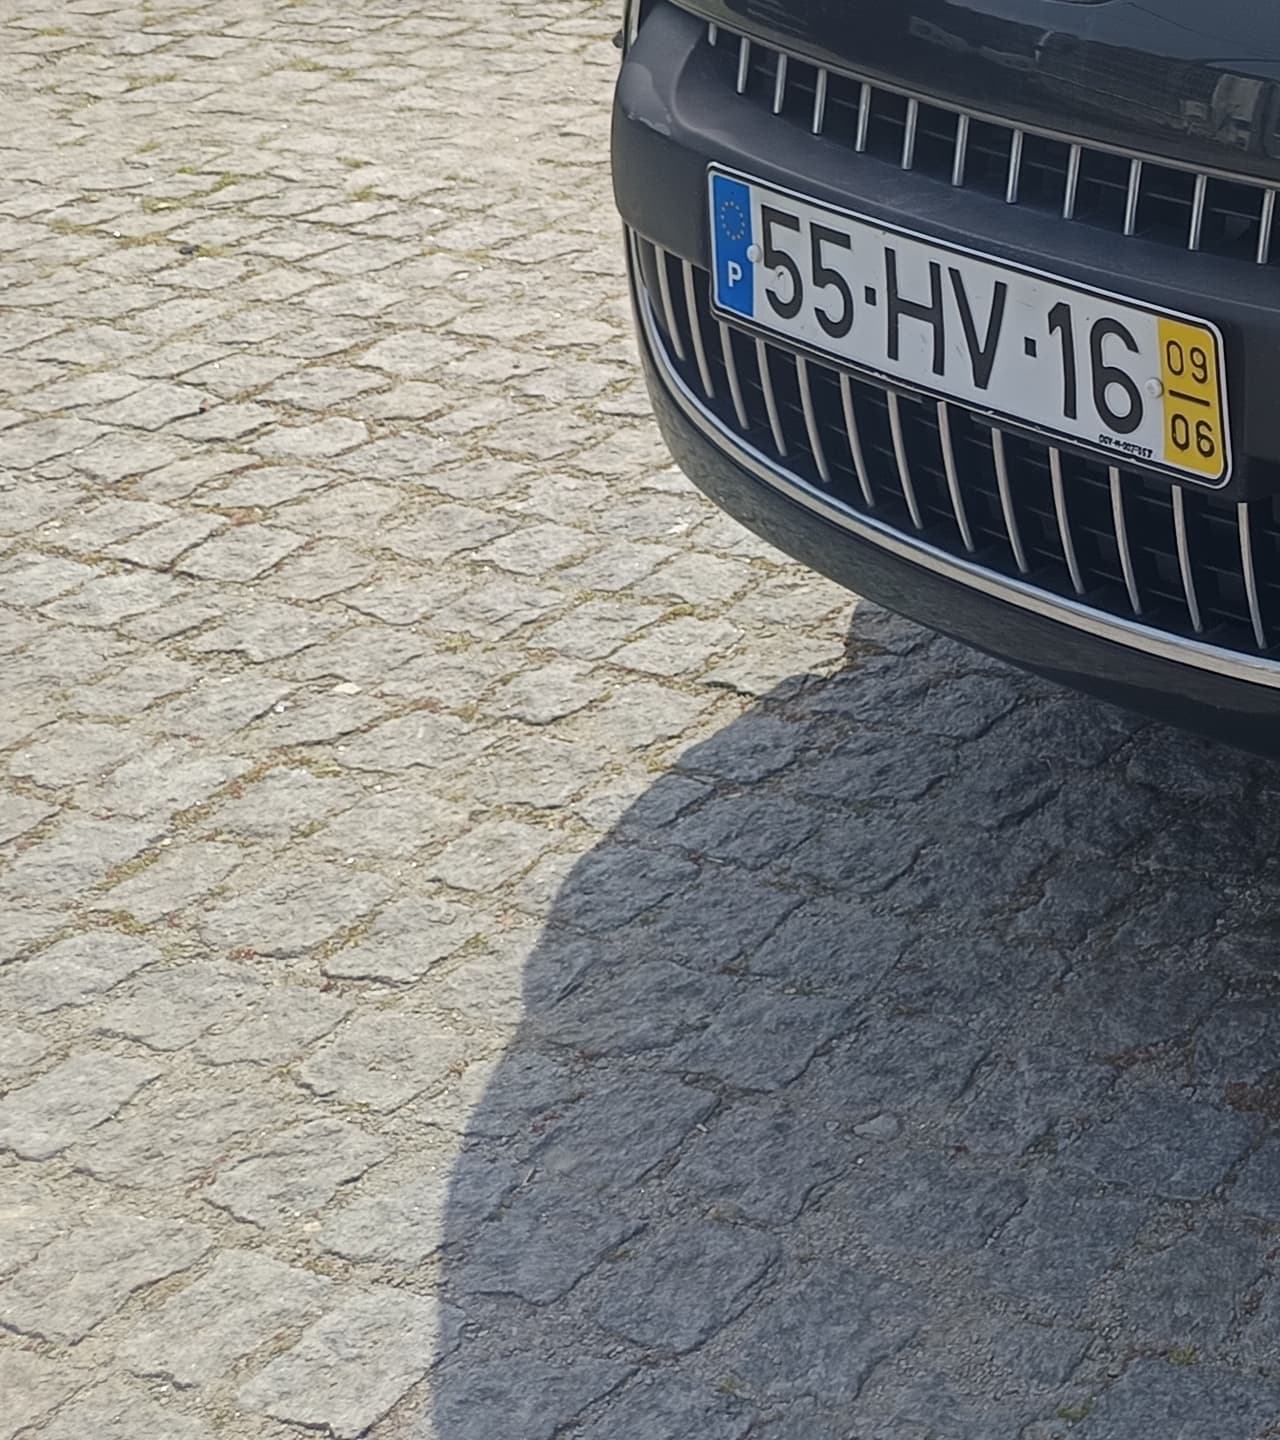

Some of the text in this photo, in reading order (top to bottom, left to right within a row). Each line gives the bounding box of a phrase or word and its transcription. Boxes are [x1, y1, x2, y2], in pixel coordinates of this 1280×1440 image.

[727, 261, 743, 288] P
[1165, 339, 1209, 385] 09
[1171, 413, 1216, 459] 06
